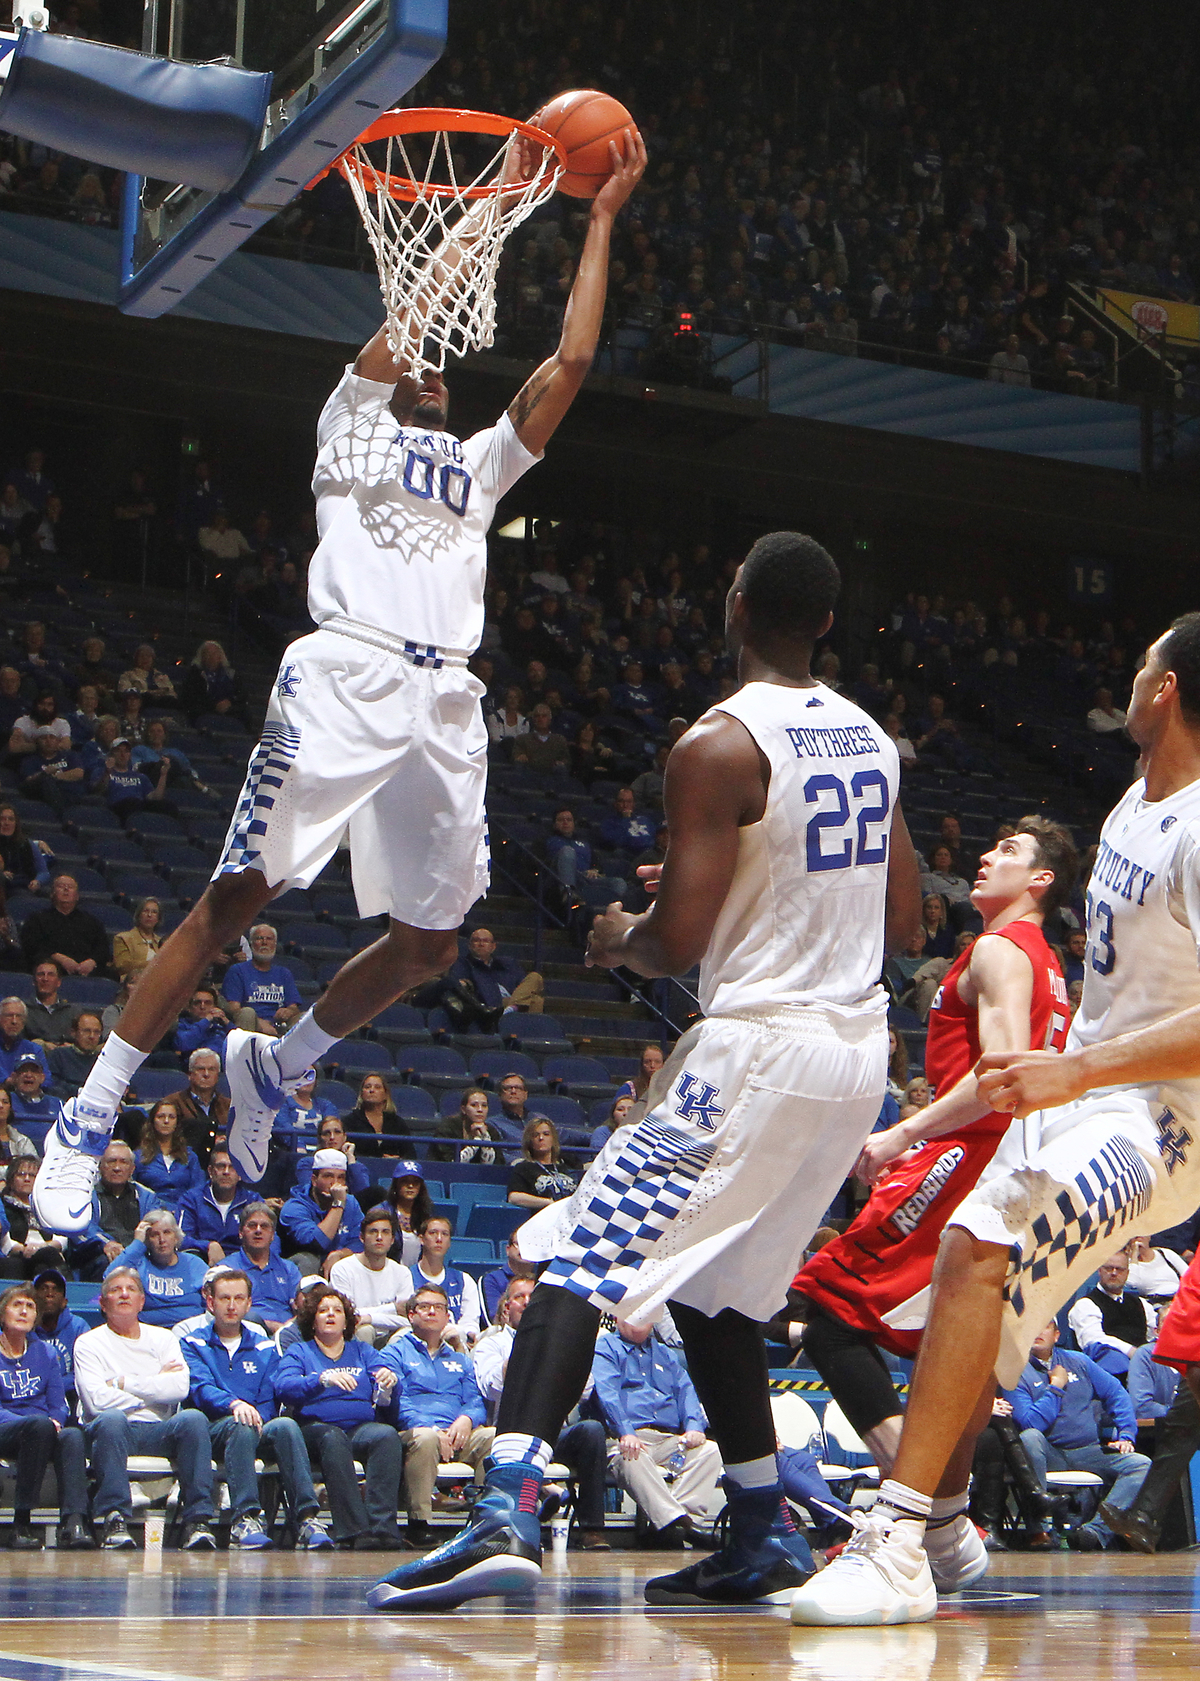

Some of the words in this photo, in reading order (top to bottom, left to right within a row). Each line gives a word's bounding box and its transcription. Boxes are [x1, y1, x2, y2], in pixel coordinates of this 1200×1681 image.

[402, 450, 471, 517] 00
[1075, 566, 1106, 594] 15
[785, 725, 880, 758] POYTHRESS
[804, 769, 890, 873] 22
[675, 1070, 725, 1133] UK
[890, 1145, 966, 1237] REDBIRDS
[149, 1273, 184, 1296] UK
[0, 1368, 41, 1399] UK
